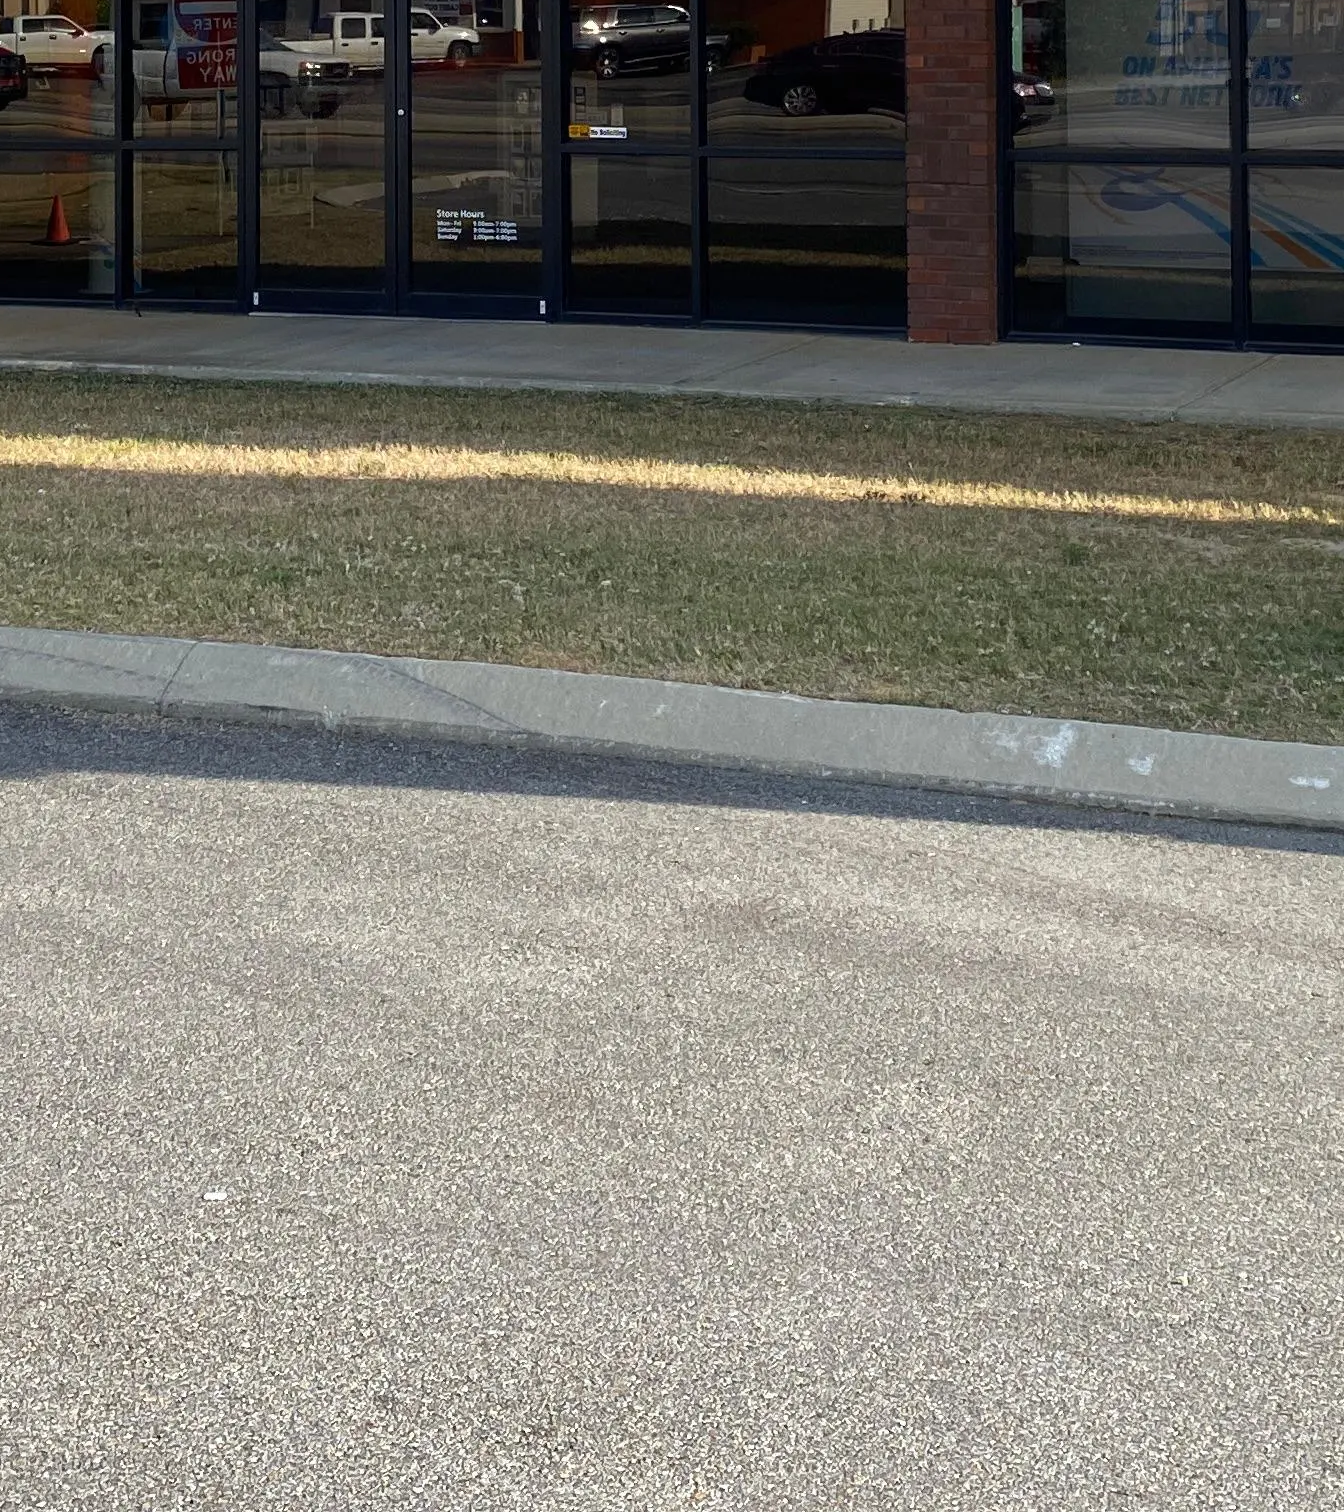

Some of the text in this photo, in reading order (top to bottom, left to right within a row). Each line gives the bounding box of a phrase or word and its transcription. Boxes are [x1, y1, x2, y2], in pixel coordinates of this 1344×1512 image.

[1123, 55, 1156, 77] ON
[1179, 84, 1302, 107] NETORK
[436, 209, 485, 218] Store Hours
